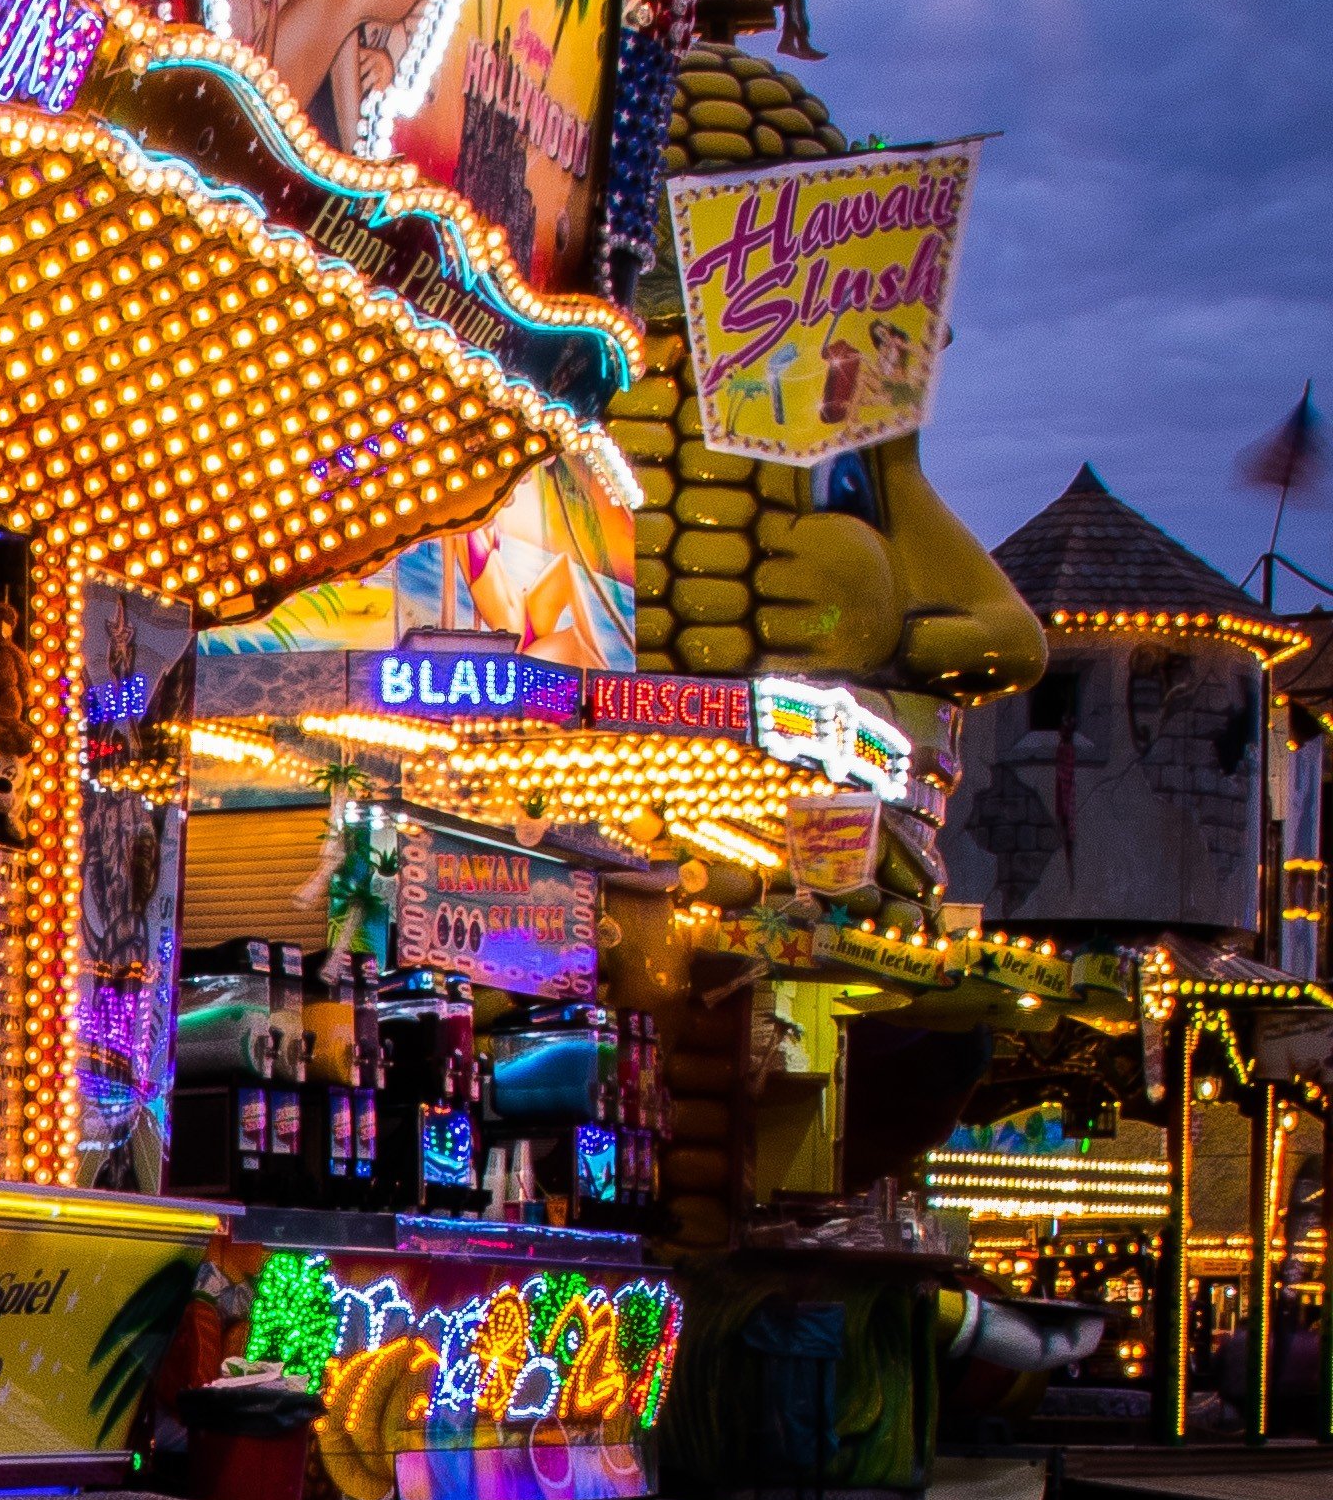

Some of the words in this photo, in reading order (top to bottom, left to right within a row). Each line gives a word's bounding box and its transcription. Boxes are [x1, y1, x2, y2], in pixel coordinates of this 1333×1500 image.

[463, 38, 592, 180] HOLLYWOOD
[684, 174, 962, 296] Hawaii
[305, 194, 397, 280] Happy
[395, 248, 509, 350] Playtime
[701, 234, 948, 399] Slush
[379, 656, 519, 706] BLAU
[594, 677, 749, 730] KIRSCHE
[435, 853, 532, 894] HAWAII
[487, 904, 567, 943] SLUSH
[879, 947, 933, 977] lecker
[1001, 951, 1027, 975] Der
[1029, 963, 1066, 994] Mais
